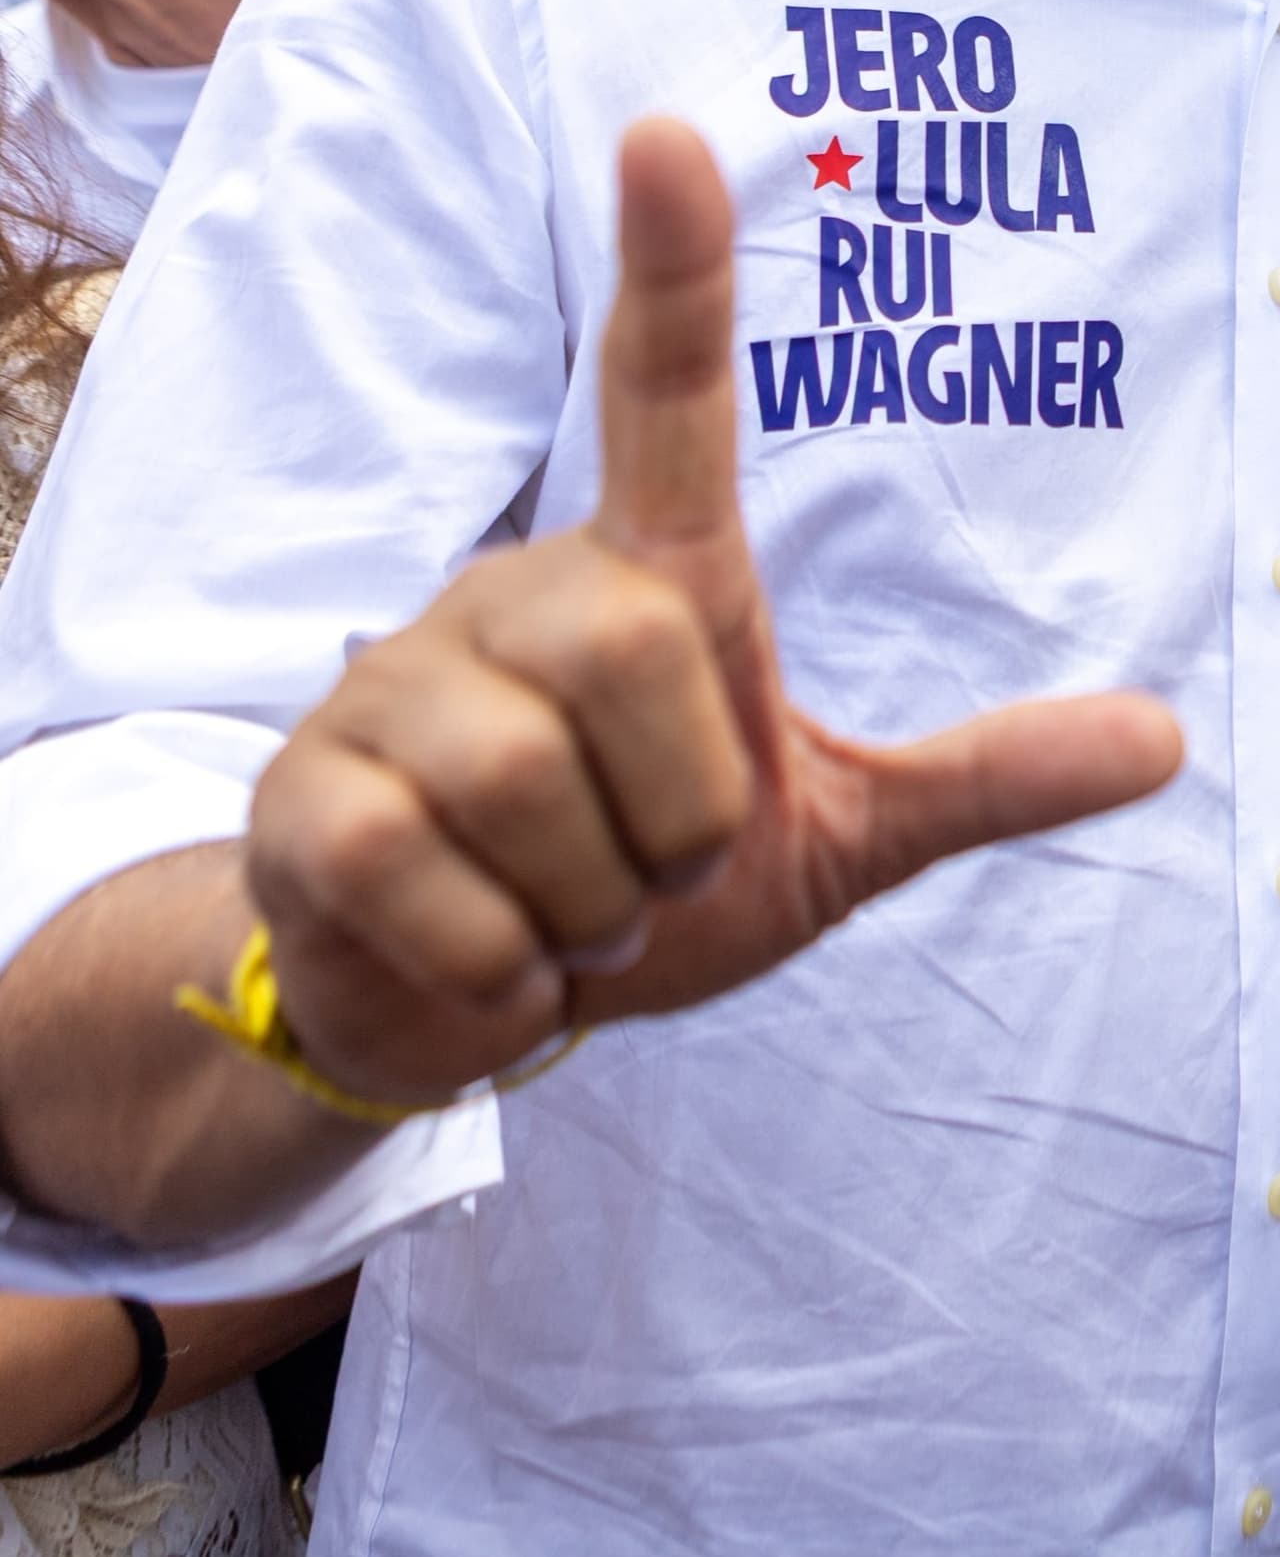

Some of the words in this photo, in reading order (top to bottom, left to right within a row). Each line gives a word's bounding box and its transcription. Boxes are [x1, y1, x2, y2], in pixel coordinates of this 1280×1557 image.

[769, 5, 1017, 118] JERO
[876, 119, 1096, 233] LULA
[819, 216, 954, 328] RUI
[749, 320, 1125, 433] WAGNER
